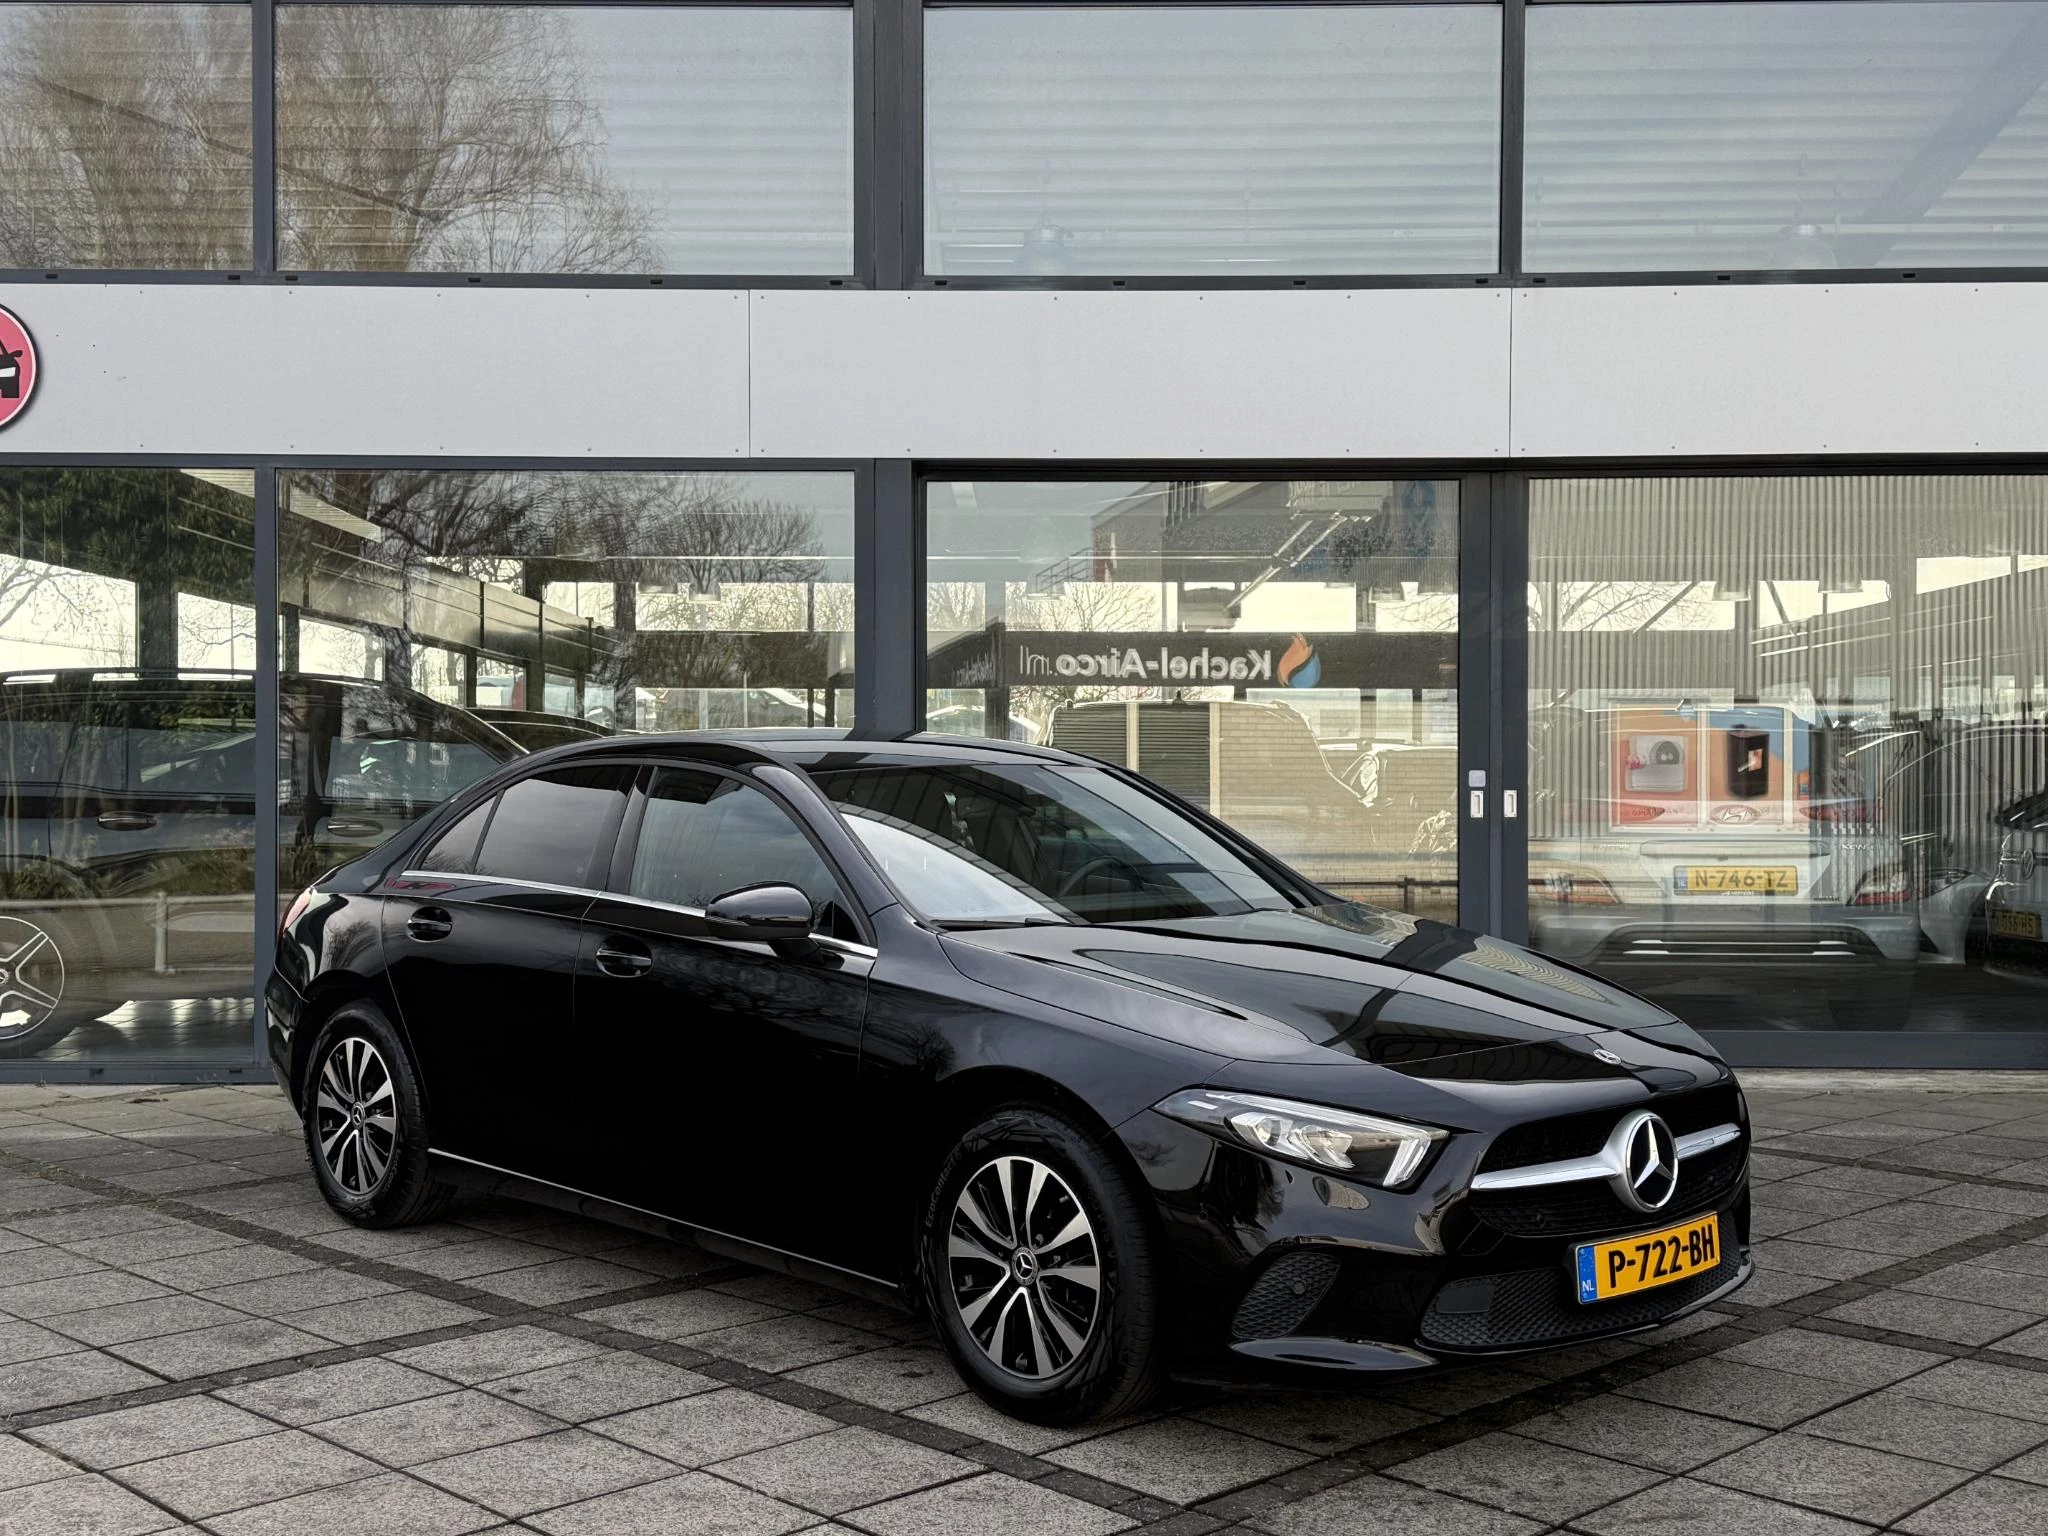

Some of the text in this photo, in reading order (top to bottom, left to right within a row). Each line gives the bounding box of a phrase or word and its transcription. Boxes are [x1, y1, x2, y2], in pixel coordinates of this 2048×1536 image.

[1694, 869, 1788, 888] N-746-TZ
[1607, 1223, 1715, 1288] P-722-BH
[1582, 1279, 1595, 1293] NL
